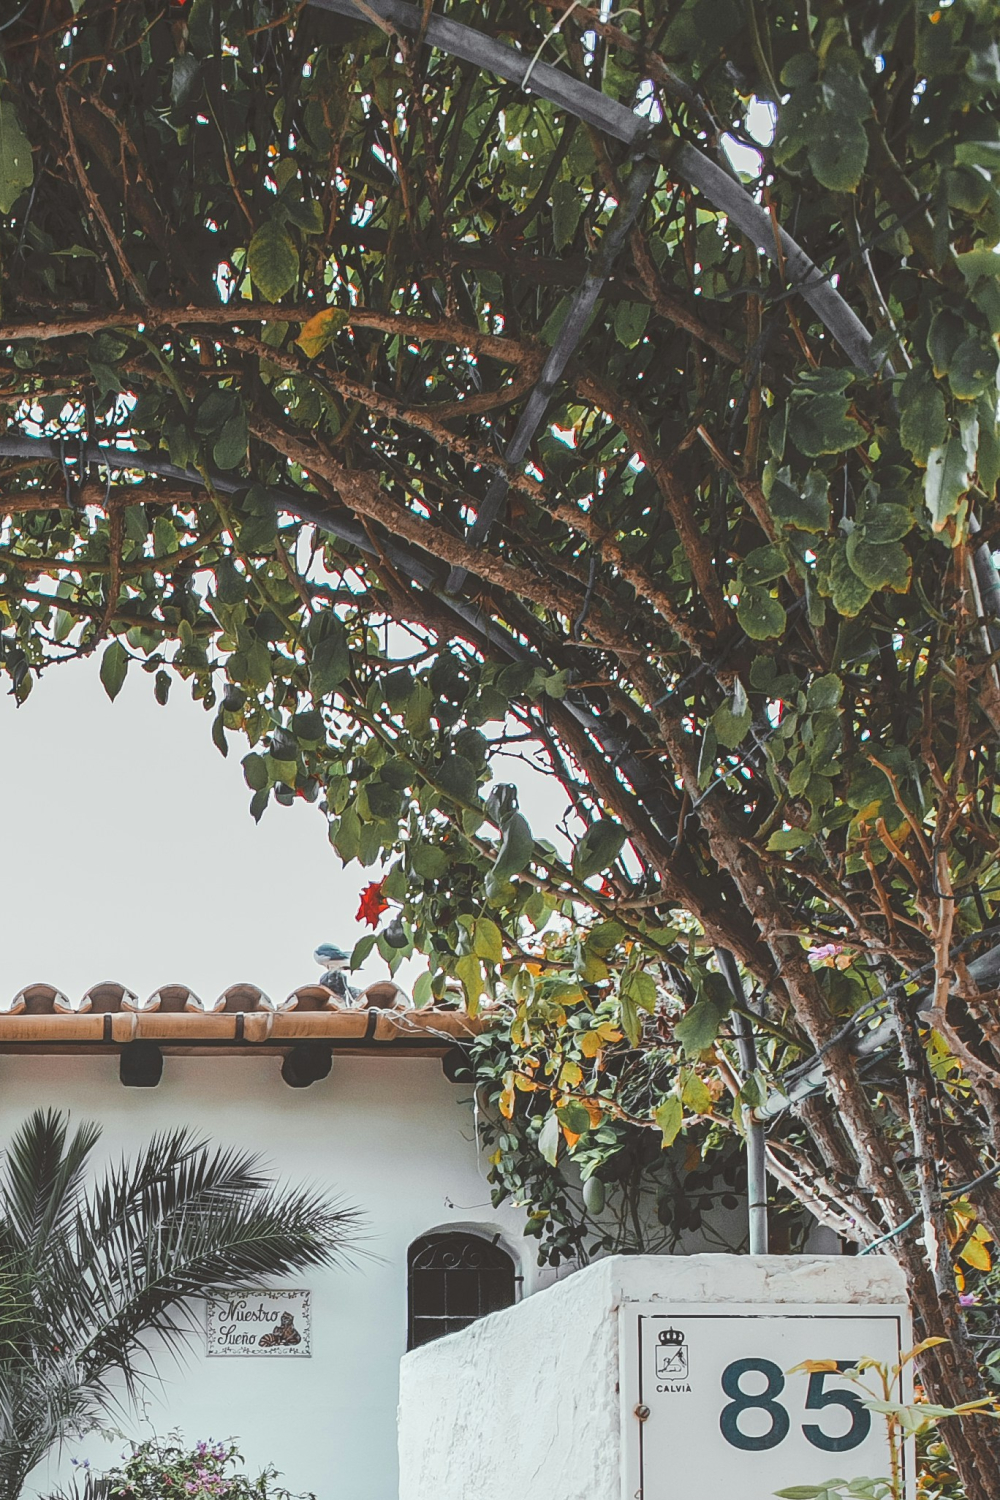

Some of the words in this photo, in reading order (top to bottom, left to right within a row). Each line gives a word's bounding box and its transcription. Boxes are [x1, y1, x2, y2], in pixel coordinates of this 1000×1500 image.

[218, 1300, 281, 1322] Nuestro
[217, 1324, 257, 1345] Sueño
[656, 1382, 692, 1393] CALVIÀ
[719, 1357, 872, 1453] 85
